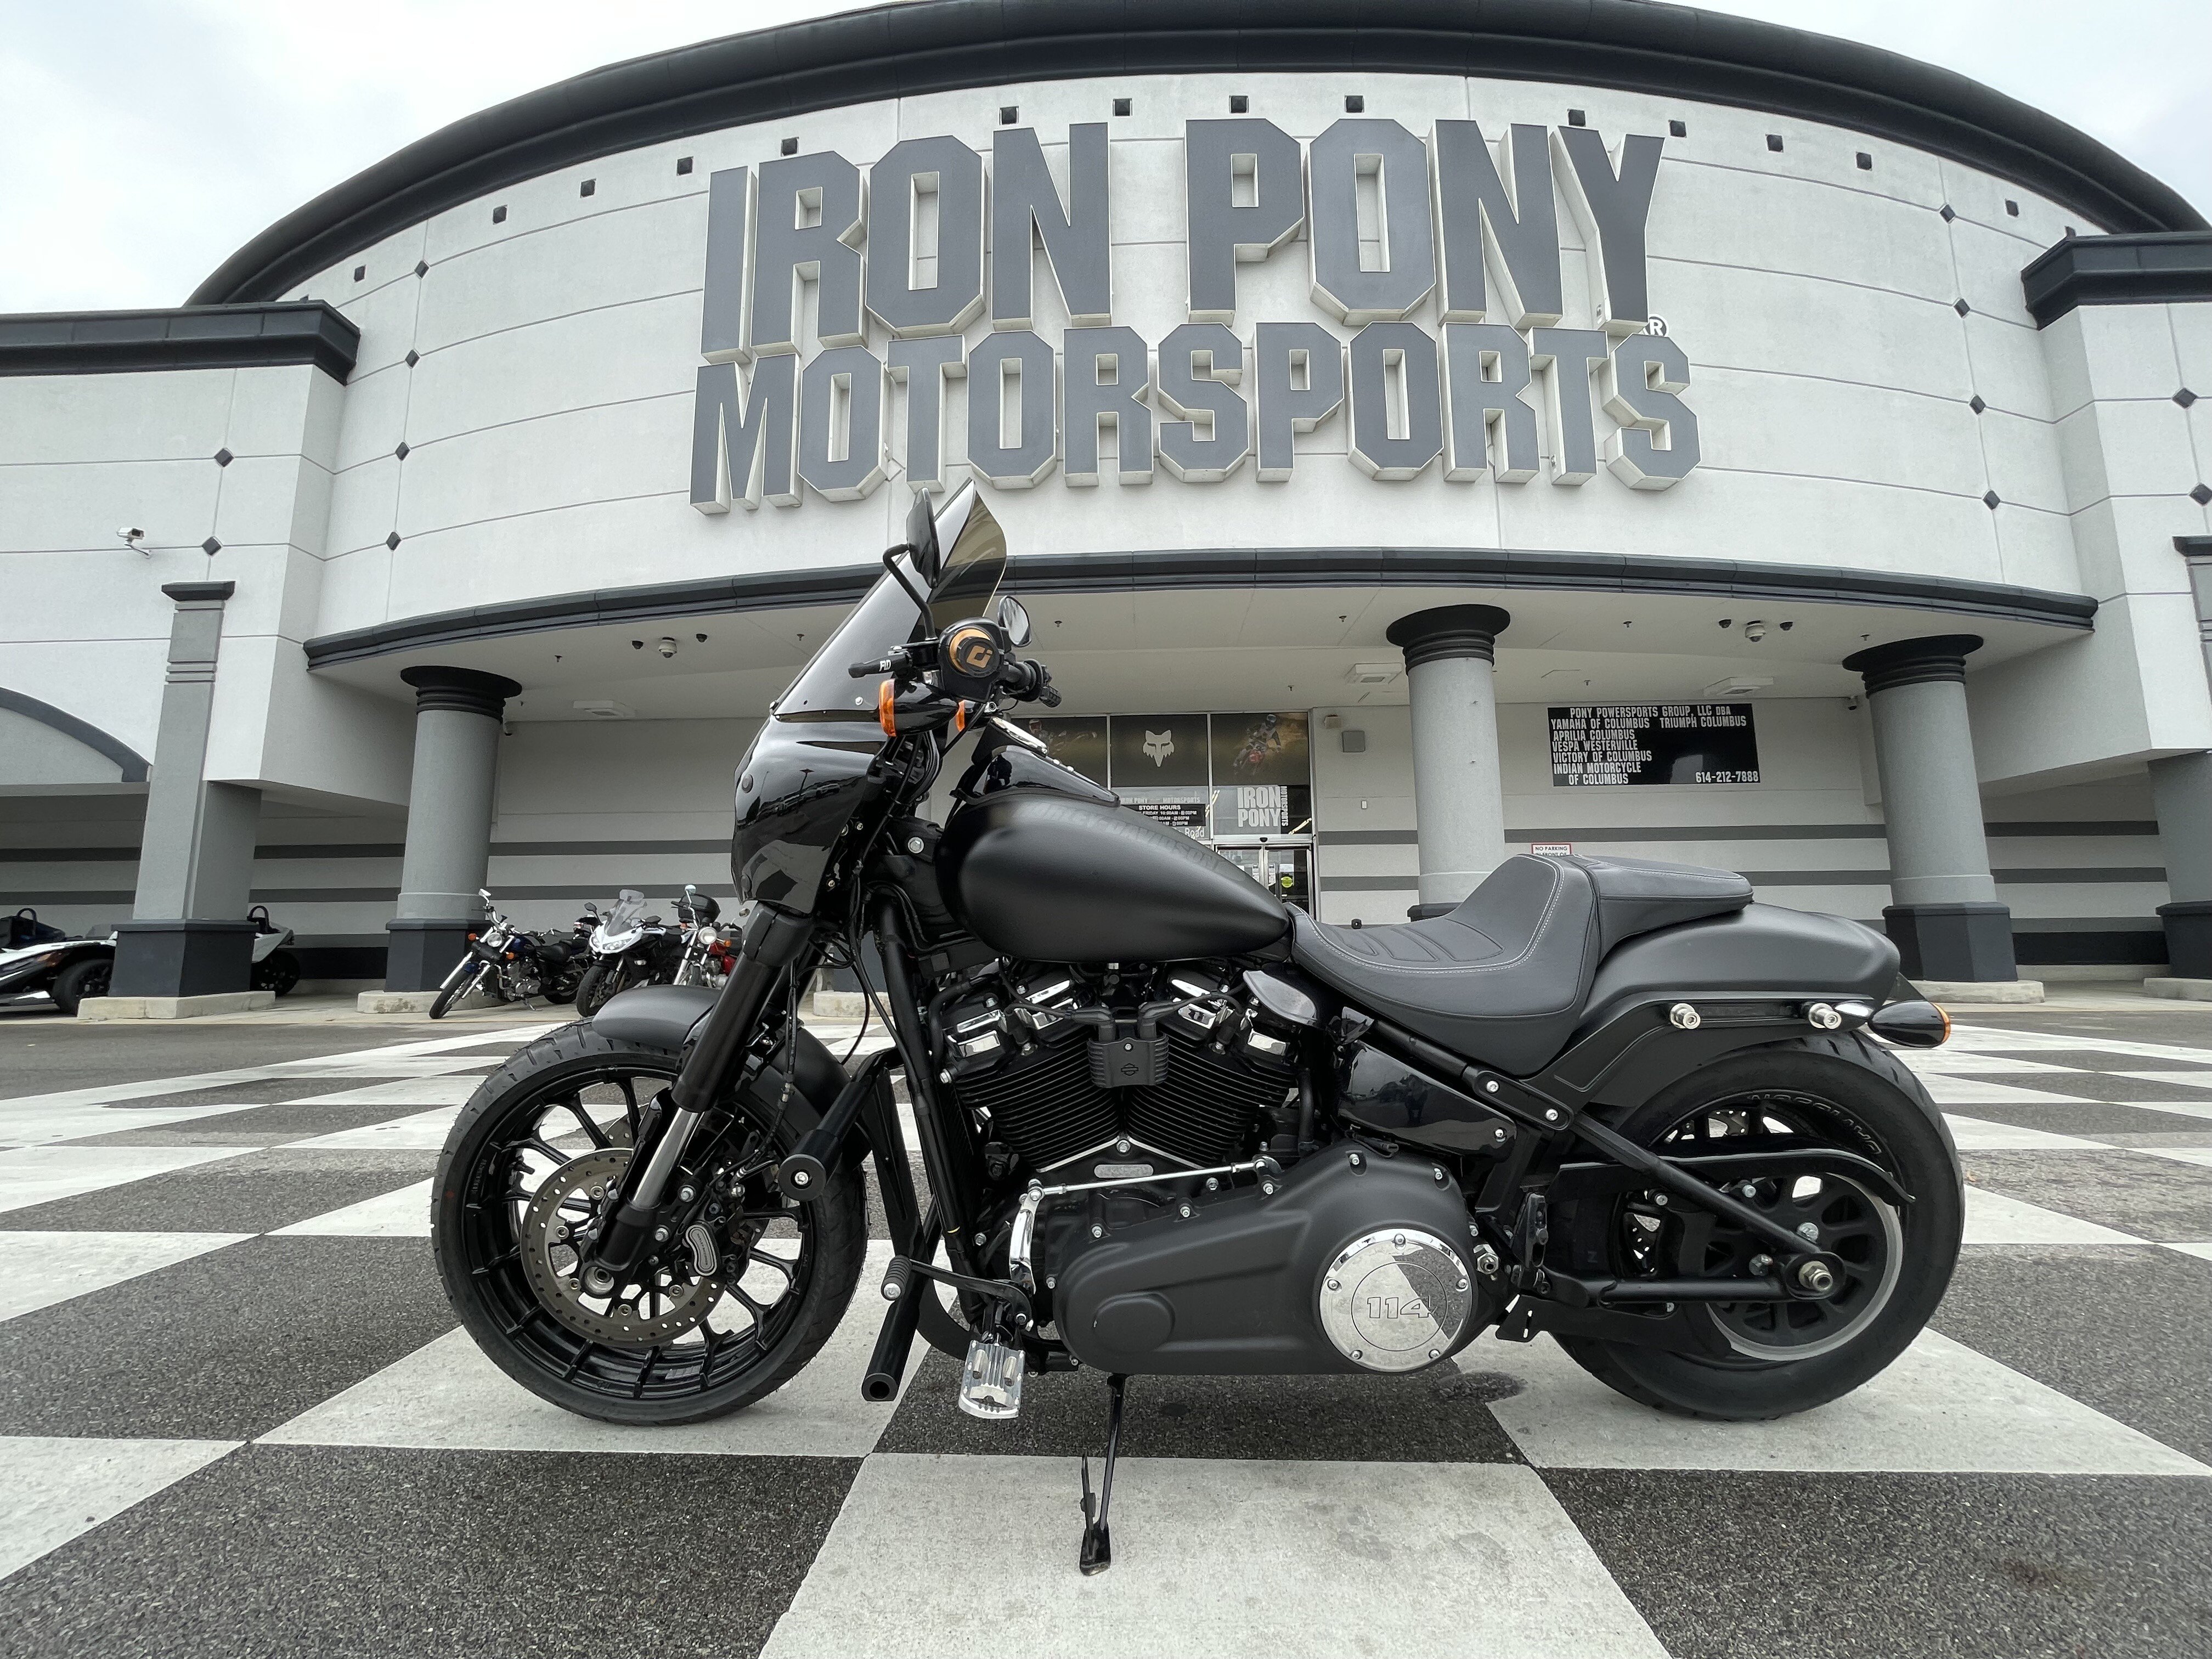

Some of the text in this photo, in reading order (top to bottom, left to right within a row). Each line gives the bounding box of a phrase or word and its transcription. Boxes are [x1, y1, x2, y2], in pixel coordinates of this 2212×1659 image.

[701, 118, 1666, 360] IRON PONY
[689, 320, 1702, 514] MOTORSPORTS
[1570, 708, 1592, 718] PONY
[1596, 707, 1658, 718] POWERSPORTS
[1697, 705, 1712, 716] LLC
[1716, 706, 1731, 715] DBA
[1551, 718, 1650, 730] YAMAHA OF COLUMBUS
[1660, 715, 1747, 729] TRIUMPH COLUMBUS
[1553, 729, 1635, 741] APRILIA COLUMBUS
[1552, 740, 1638, 752] VESPA WESTERVILLE
[1553, 751, 1652, 763] VICTORY OF COLUMBUS
[1554, 762, 1641, 774] INDIAN MOTORCYCLE
[1568, 773, 1628, 785] OF COLUMBUS
[1695, 771, 1759, 783] 614-212-7888
[1237, 786, 1281, 827] IRON PONY
[1280, 786, 1289, 826] MOTORSPORTS
[1184, 827, 1205, 838] Road
[1367, 1295, 1437, 1319] 114
